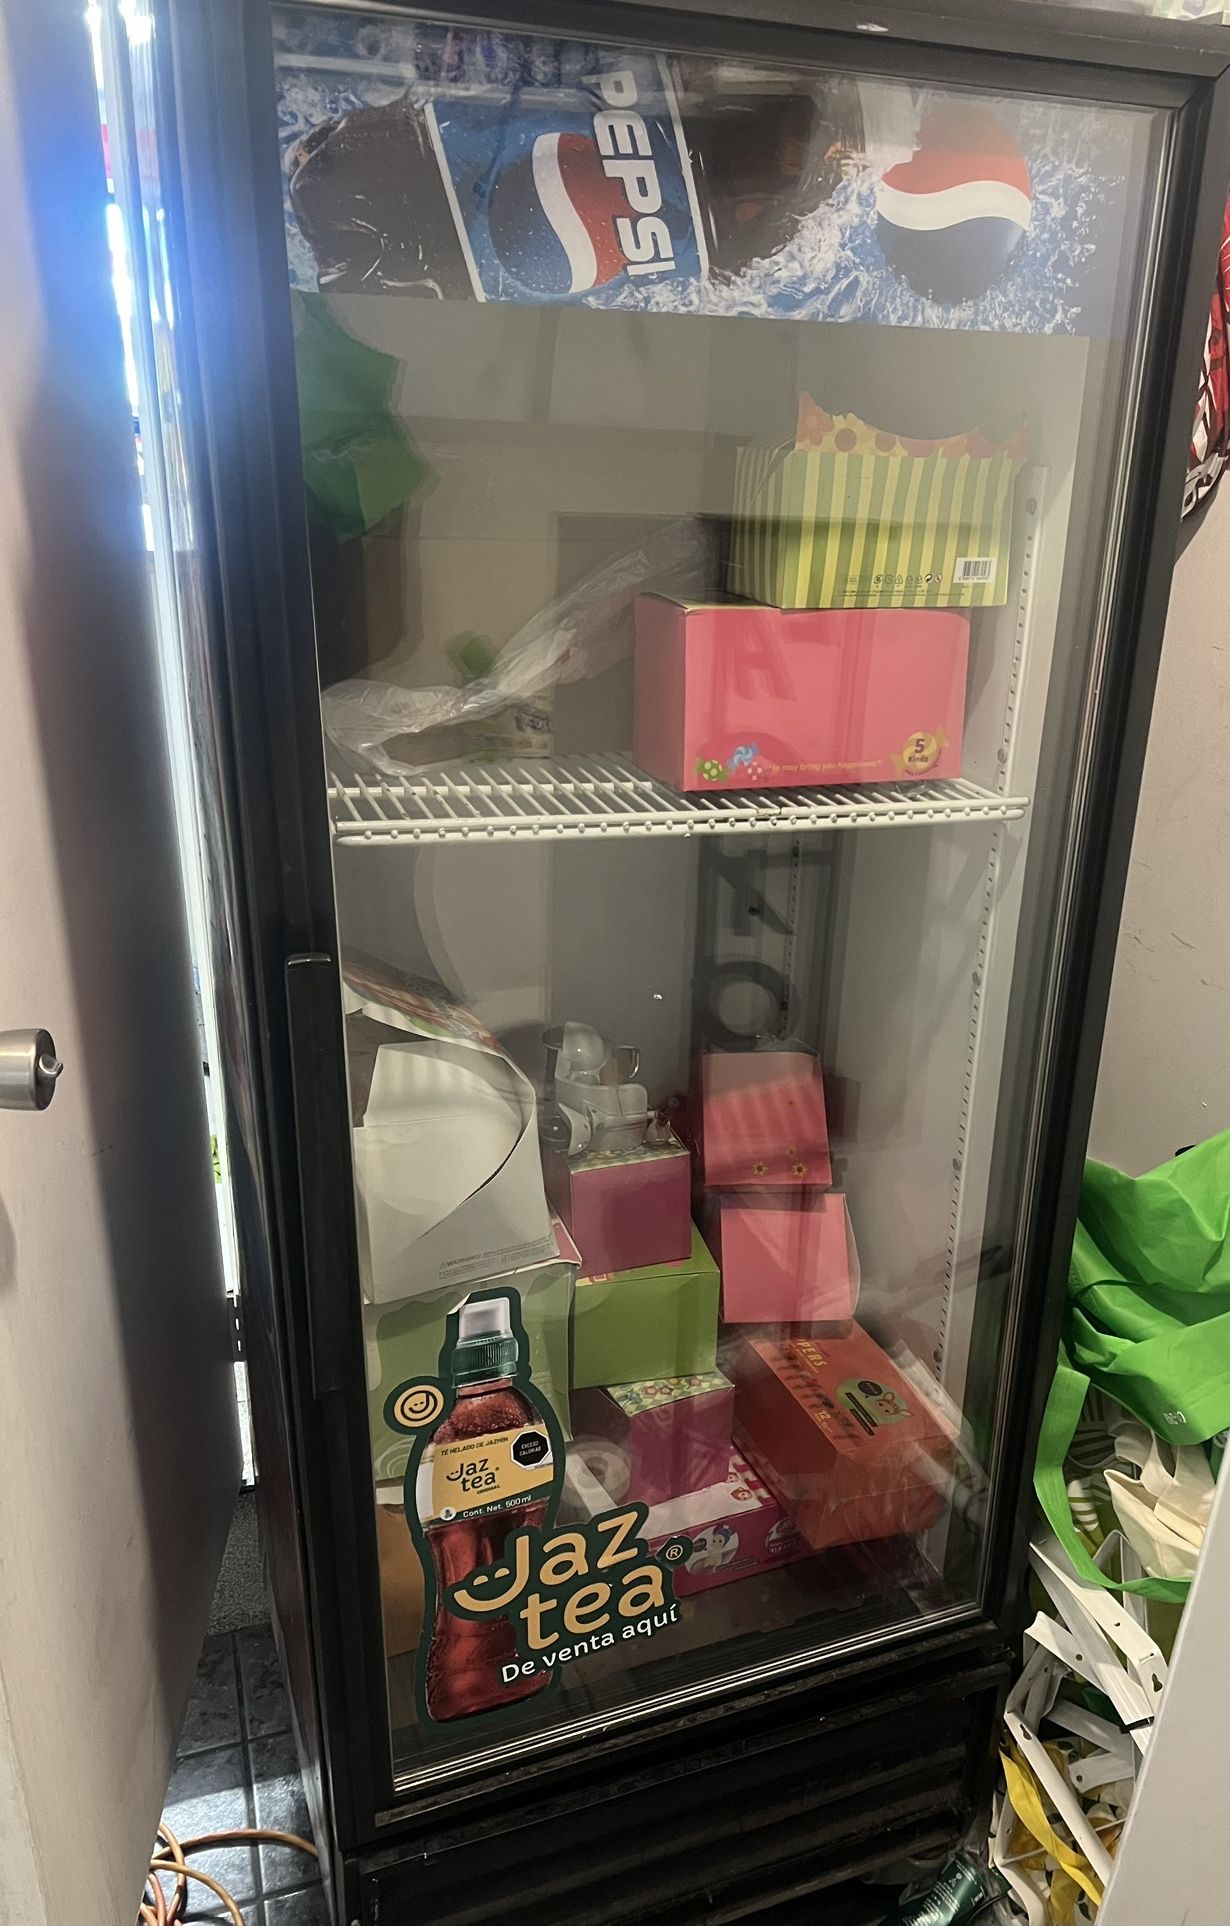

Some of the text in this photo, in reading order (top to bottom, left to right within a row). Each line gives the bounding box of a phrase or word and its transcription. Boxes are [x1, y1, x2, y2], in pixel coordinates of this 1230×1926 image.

[581, 70, 676, 276] PEPSI
[914, 738, 926, 753] 5
[795, 1339, 828, 1368] PERS
[450, 1444, 475, 1454] HELADO
[446, 1458, 489, 1481] Jaz
[460, 1472, 496, 1492] tea
[505, 1497, 521, 1508] 500
[453, 1511, 639, 1612] Jaz
[520, 1565, 665, 1650] tea
[501, 1604, 677, 1683] De venta aquí
